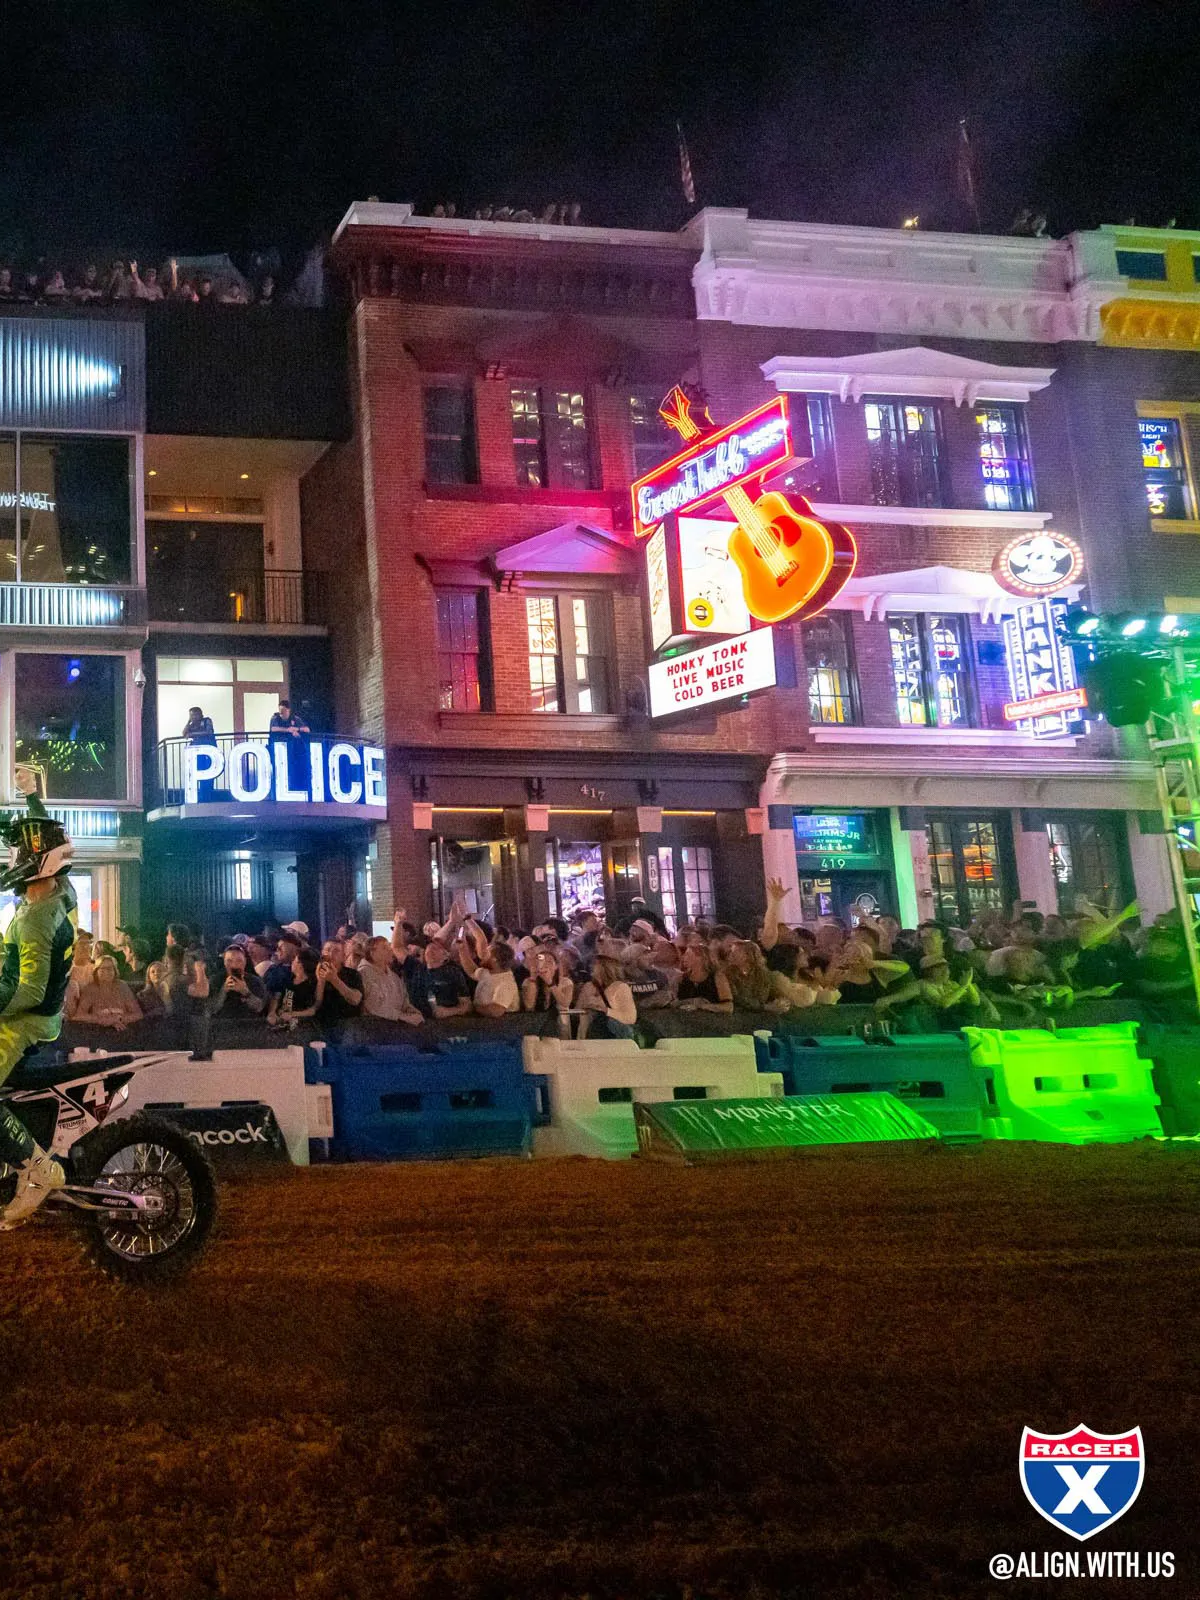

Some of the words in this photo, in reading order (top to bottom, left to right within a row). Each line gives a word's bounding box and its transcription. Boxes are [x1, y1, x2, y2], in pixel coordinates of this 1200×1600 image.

[677, 434, 745, 495] Tubb
[666, 655, 705, 677] HONKY
[712, 641, 748, 662] TONK
[1019, 602, 1058, 698] HANK
[673, 672, 698, 689] LIVE
[706, 658, 745, 679] MUSIC
[674, 686, 704, 702] COLD
[711, 674, 745, 692] BEER
[184, 741, 388, 807] POLICE
[580, 784, 606, 801] 417
[821, 858, 846, 870] 419
[82, 1079, 109, 1105] 4
[187, 1121, 268, 1146] acock
